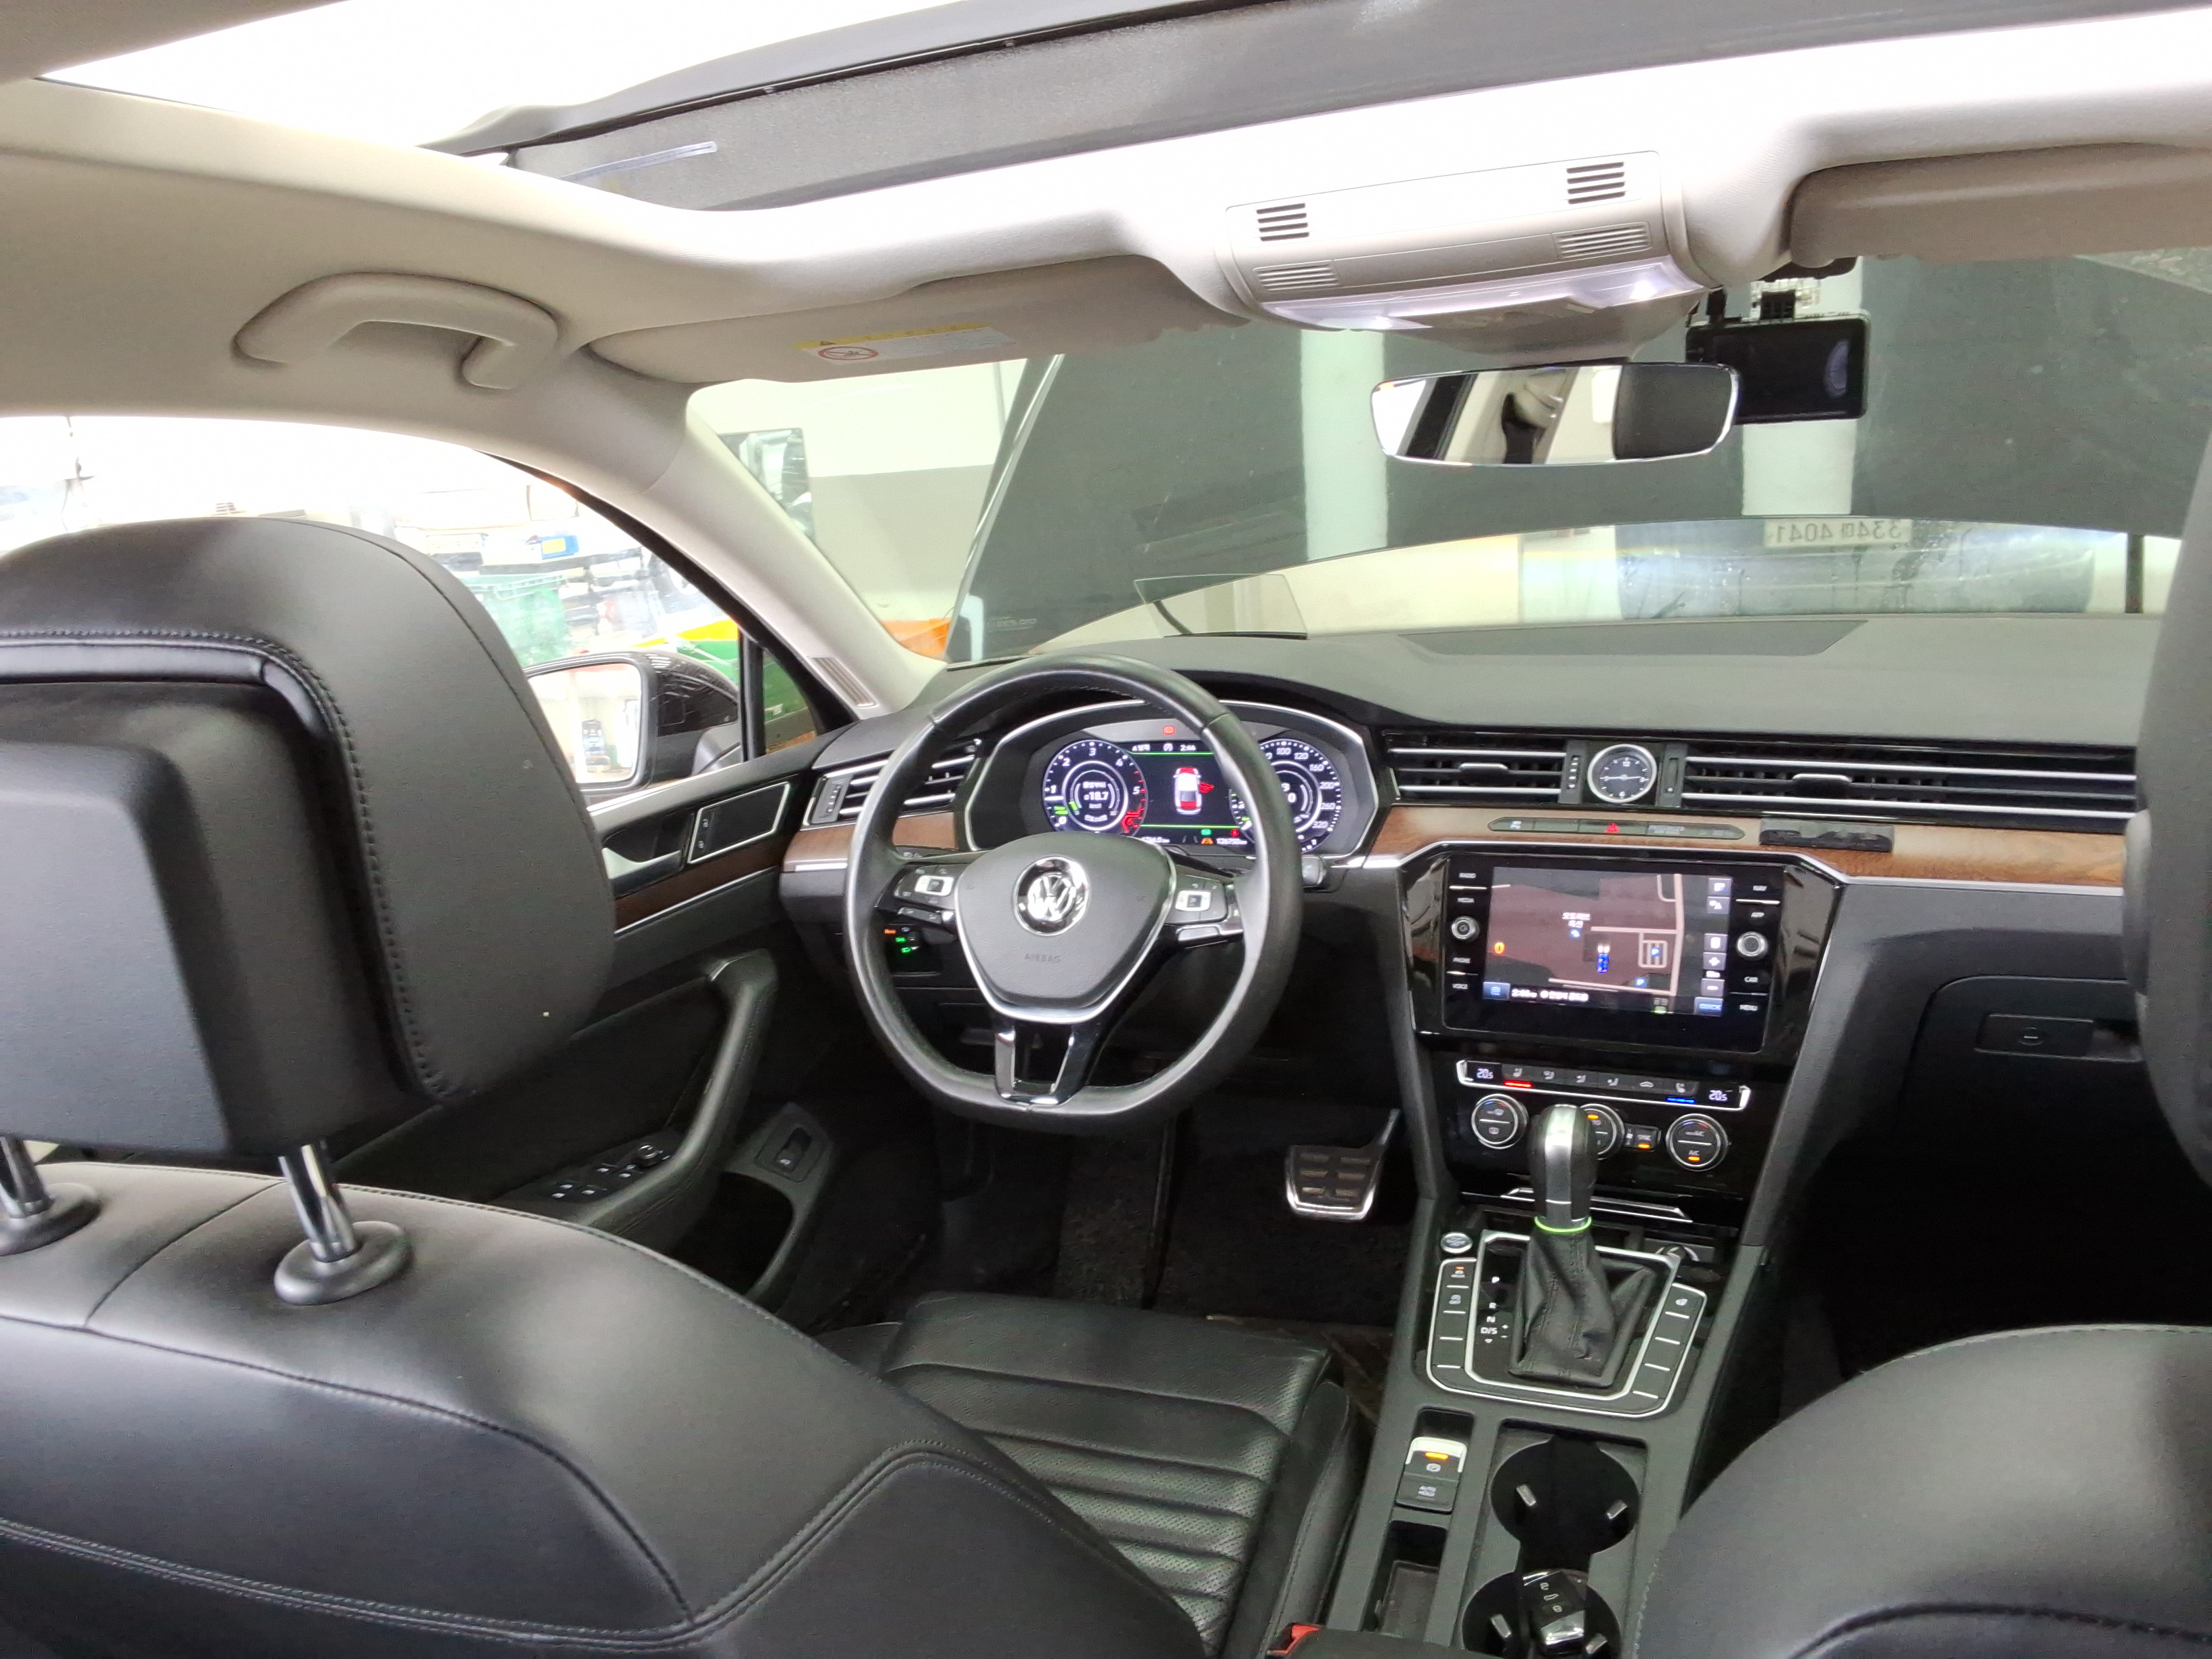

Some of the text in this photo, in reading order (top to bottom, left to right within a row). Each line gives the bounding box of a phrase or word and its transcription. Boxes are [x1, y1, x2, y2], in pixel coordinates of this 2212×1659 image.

[1088, 747, 1097, 756] 3
[1062, 758, 1070, 766] 2
[1115, 758, 1124, 766] 4
[1050, 785, 1057, 794] 1
[1132, 786, 1141, 795] 5
[1059, 816, 1067, 825] 0
[1480, 1326, 1498, 1334] D/S
